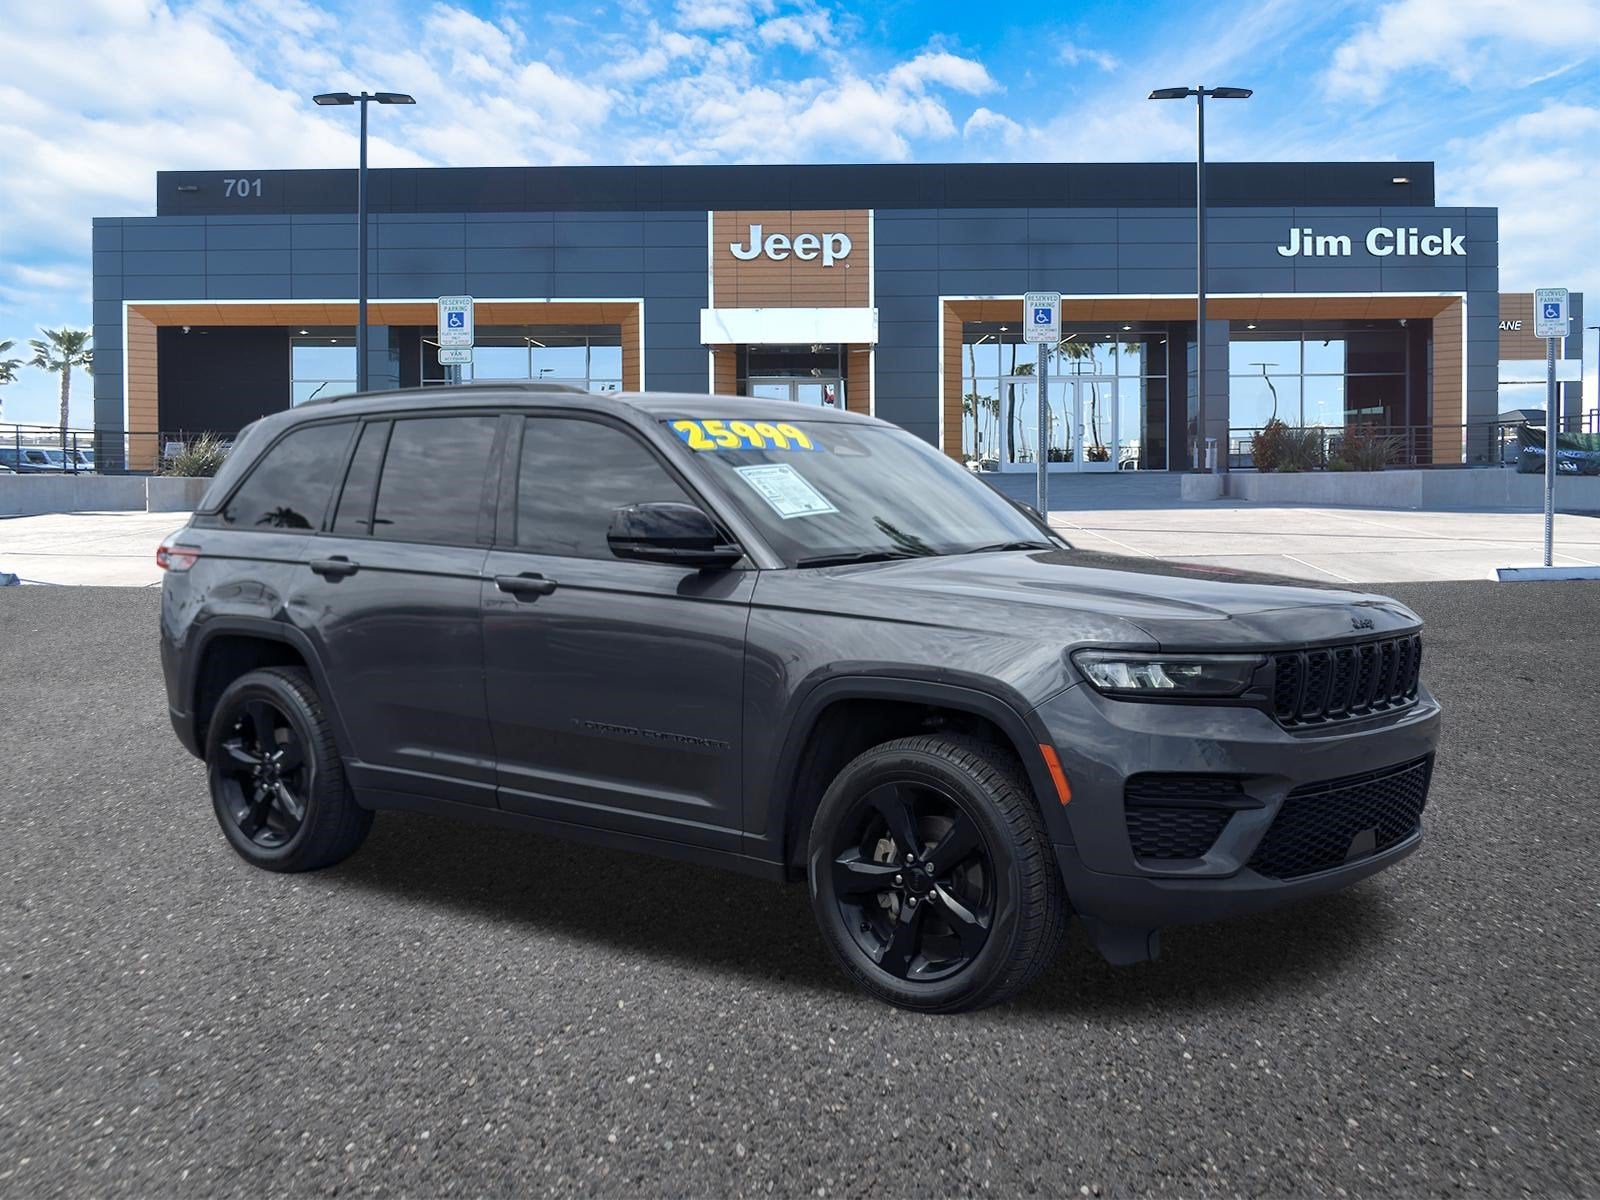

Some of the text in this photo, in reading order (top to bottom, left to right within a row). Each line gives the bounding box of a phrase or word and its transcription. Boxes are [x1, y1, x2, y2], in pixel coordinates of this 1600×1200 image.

[224, 178, 262, 197] 701
[730, 224, 852, 267] Jeep
[1277, 227, 1467, 257] Jim Click
[672, 420, 815, 450] 25999
